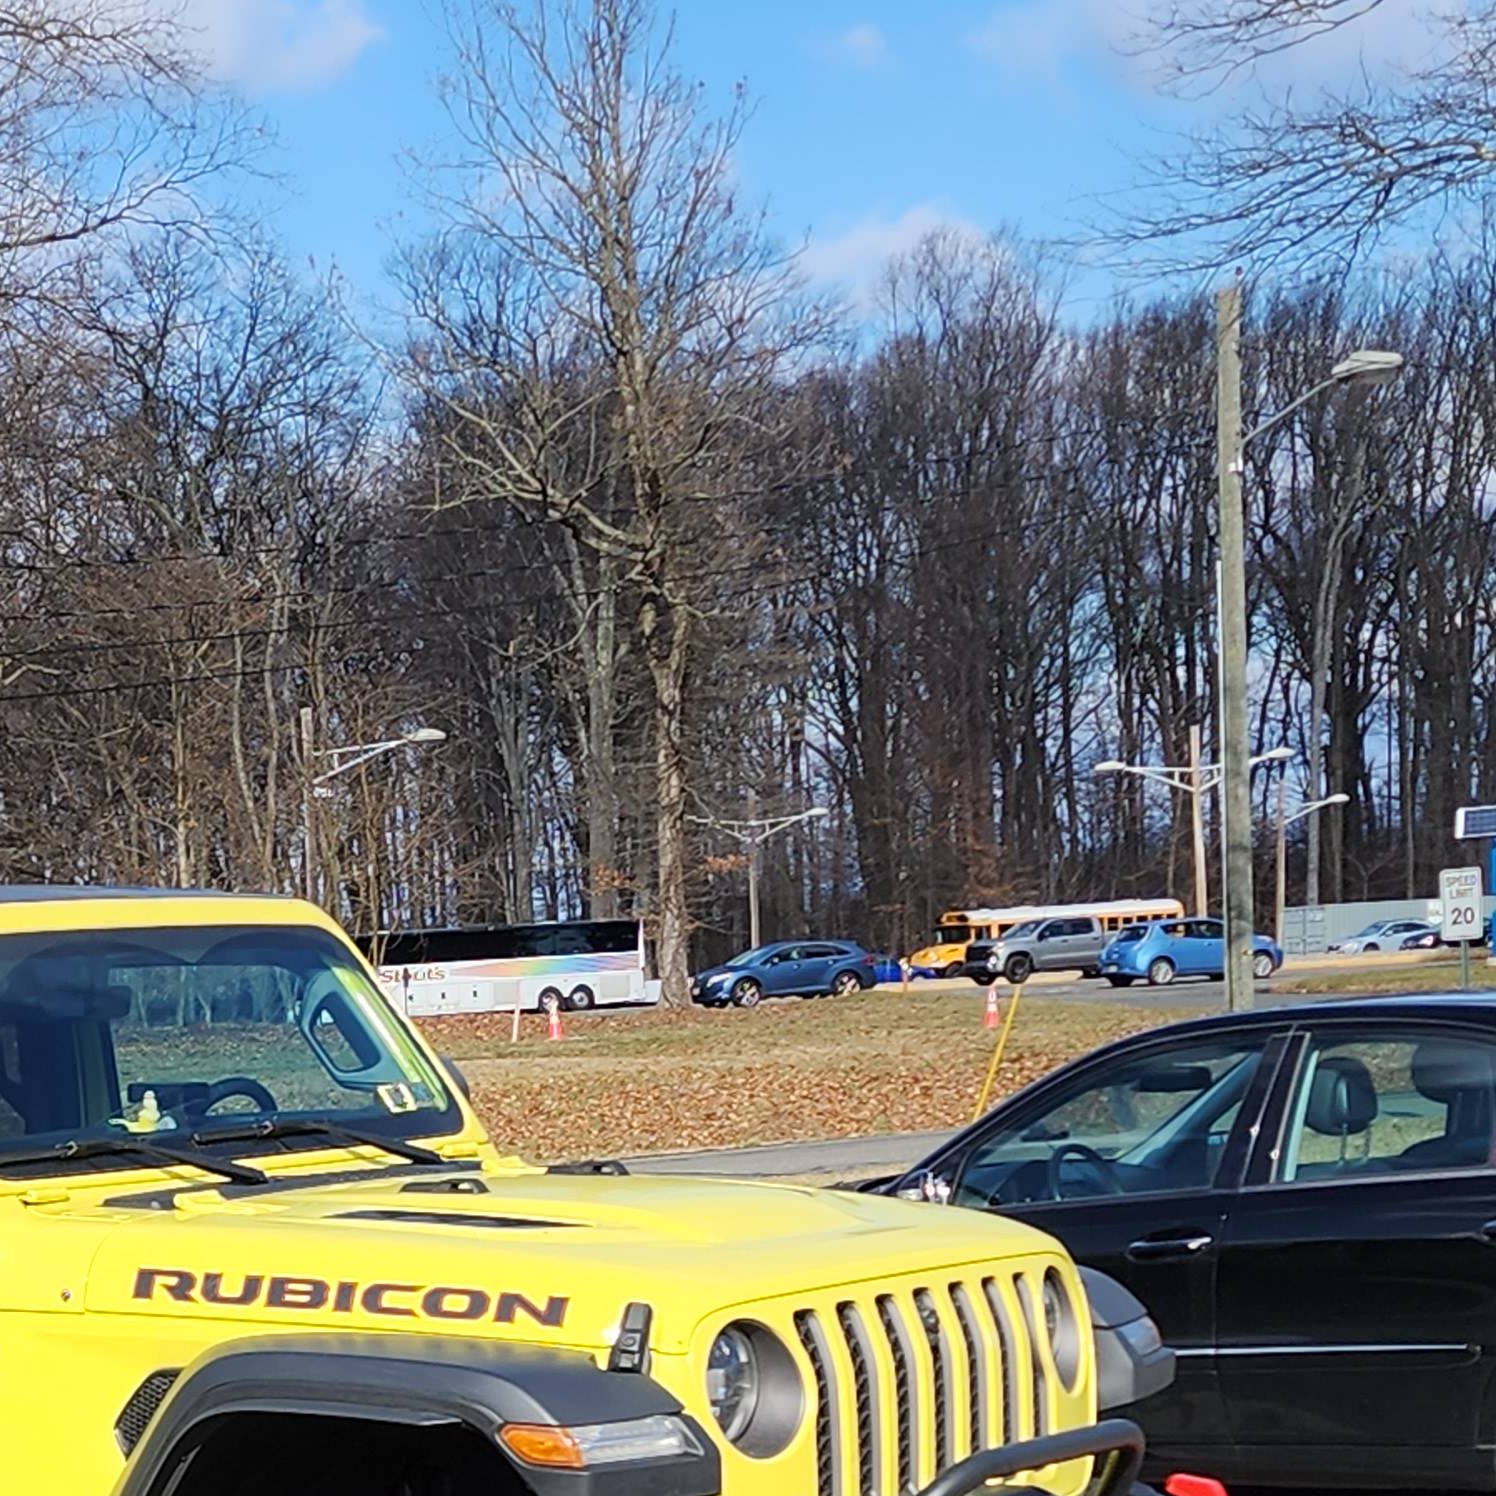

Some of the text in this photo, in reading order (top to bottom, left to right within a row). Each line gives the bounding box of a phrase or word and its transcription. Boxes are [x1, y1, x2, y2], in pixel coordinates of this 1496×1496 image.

[1445, 874, 1476, 888] SPEED
[1449, 887, 1474, 899] LIMIT
[1451, 907, 1475, 925] 20
[132, 1268, 571, 1328] RUBICON
